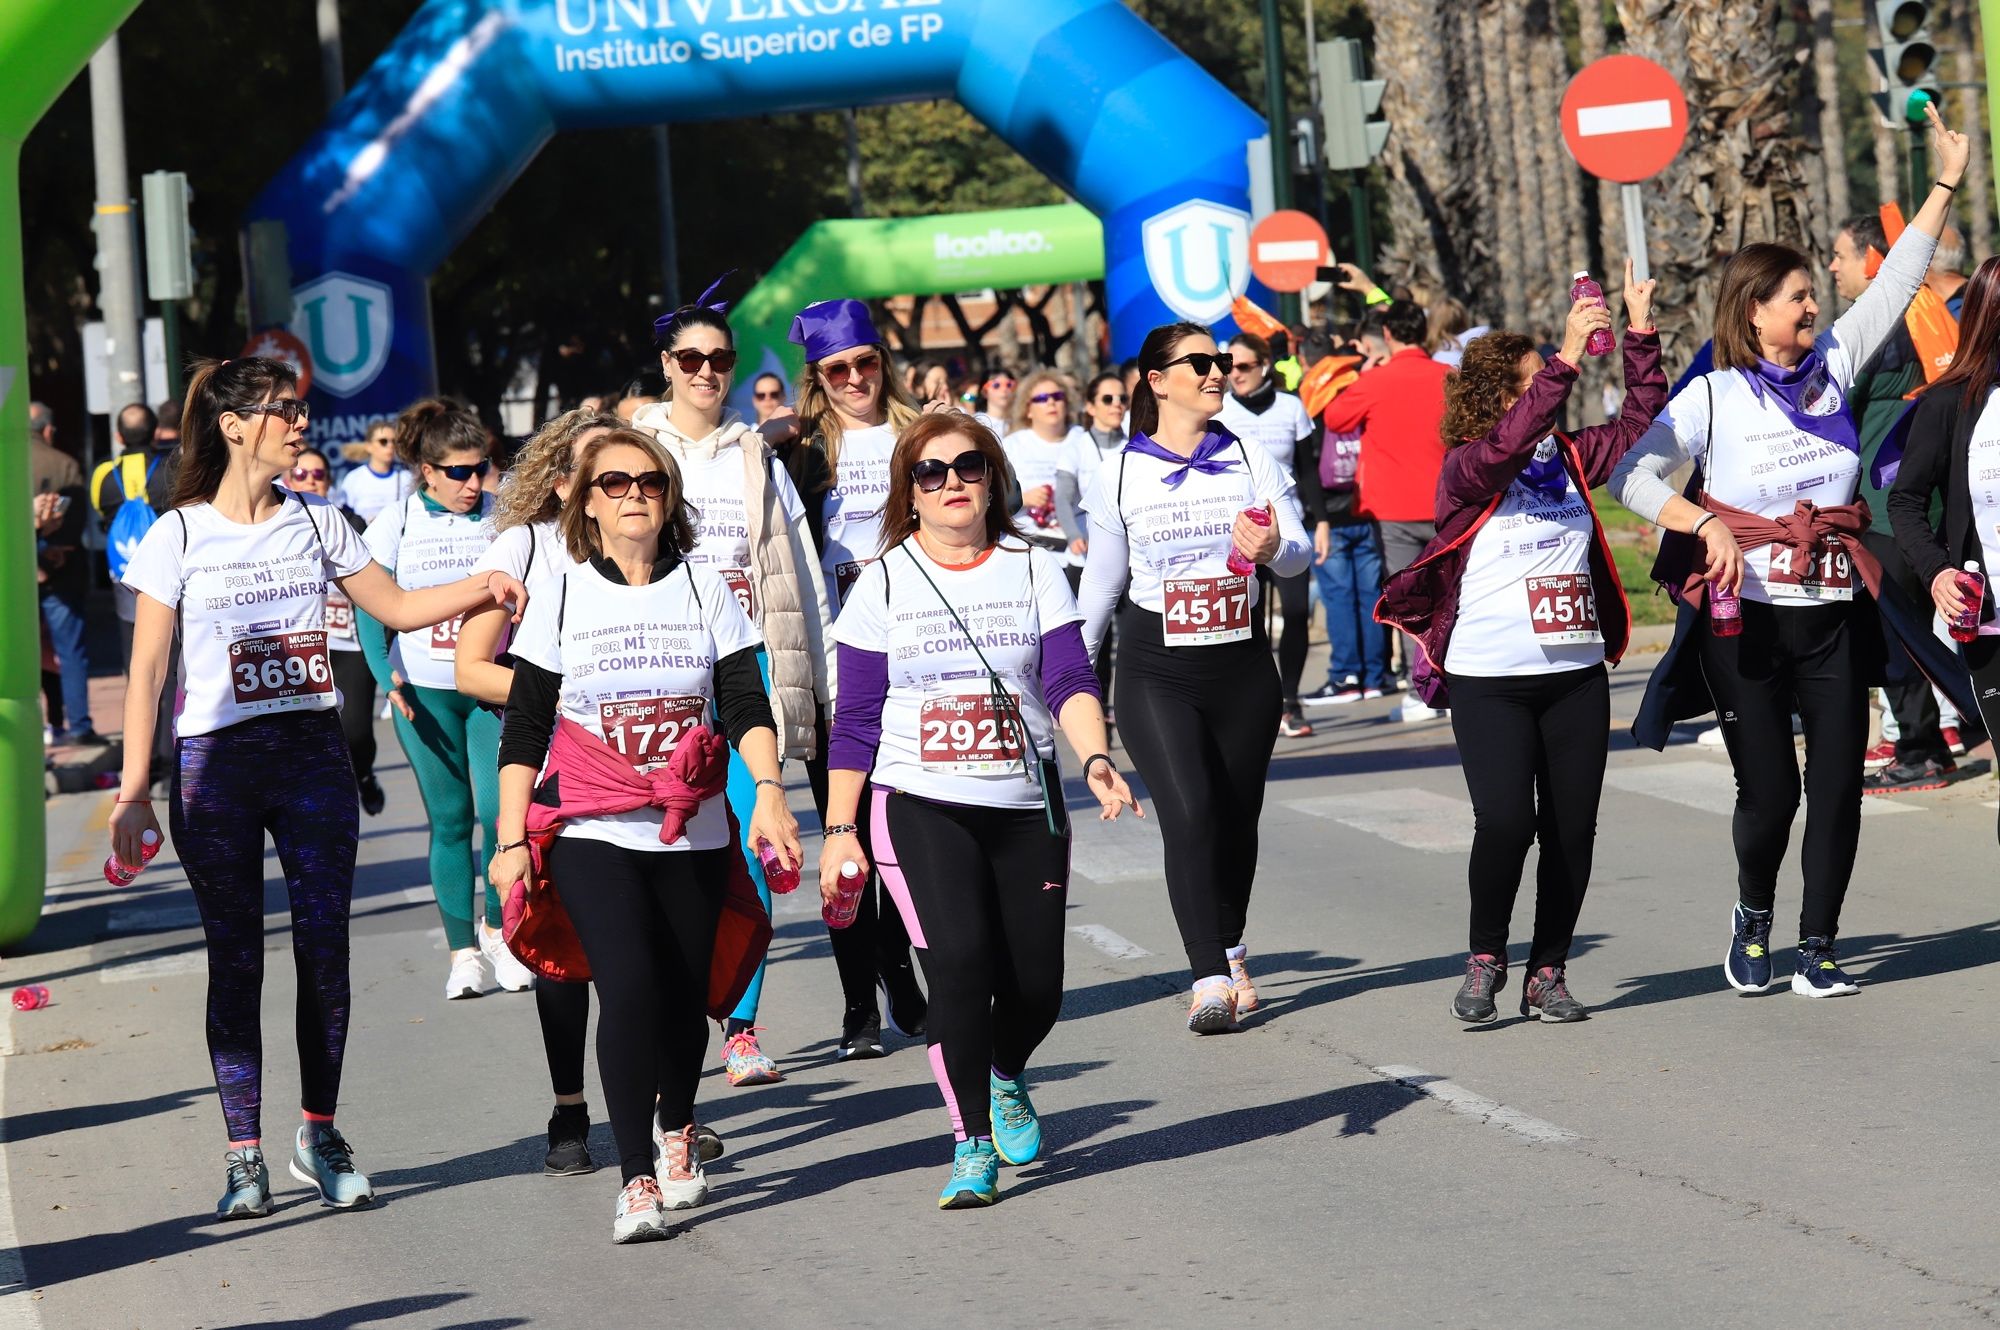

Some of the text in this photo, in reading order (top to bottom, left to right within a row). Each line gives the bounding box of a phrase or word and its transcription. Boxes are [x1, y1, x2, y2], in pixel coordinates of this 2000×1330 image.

[556, 0, 942, 36] UNIVE
[555, 13, 943, 72] Instituto Superior de FP
[1163, 222, 1234, 302] U
[303, 294, 374, 375] U
[1745, 434, 1761, 443] VIII
[1762, 428, 1794, 441] CARRERA
[1767, 432, 1811, 456] POR MÍ
[1979, 439, 1995, 448] VIII
[1751, 442, 1849, 476] MIS COMPAÑE
[849, 467, 867, 480] MÍ
[720, 498, 744, 506] MUJER
[1144, 501, 1177, 512] CARRERA
[1179, 500, 1188, 508] DE
[1191, 498, 1201, 506] LA
[1202, 496, 1226, 504] MUJER
[708, 509, 746, 521] Y POR
[1146, 507, 1230, 528] POR MÍ Y POR
[1499, 517, 1522, 530] MIS
[699, 522, 748, 538] PAÑER
[439, 543, 454, 555] MÍ
[203, 553, 305, 574] VIII CARRERA DE LA MUJER
[1771, 548, 1849, 579] 419
[225, 565, 313, 588] POR MÍ Y POR
[1217, 576, 1245, 587] MURCIA
[1803, 579, 1826, 587] ELOISA
[206, 581, 327, 610] MIS COMPAÑERAS
[1181, 583, 1210, 597] mujer
[1545, 579, 1571, 594] mujer
[896, 613, 913, 622] VIII
[958, 605, 970, 614] DE
[972, 603, 984, 612] LA
[985, 601, 1013, 610] MUJER
[1167, 593, 1247, 625] 4517
[1532, 594, 1598, 624] 4515
[572, 631, 589, 641] VIII
[591, 625, 631, 638] CARRERA
[634, 623, 645, 631] DE
[647, 623, 658, 631] LA
[661, 623, 687, 632] MUJER
[916, 614, 1017, 637] POR MÍ Y POR
[288, 633, 323, 644] MURCIA
[592, 631, 691, 656] POR MÍ Y POR
[895, 630, 1036, 660] MIS COMPAÑERAS
[250, 641, 281, 657] mujer
[235, 653, 329, 692] 3696
[572, 651, 711, 679] MIS COMPAÑERAS
[279, 689, 297, 697] ESTY
[664, 698, 703, 708] MURCIA
[942, 700, 976, 716] mujer
[622, 705, 656, 721] mujer
[923, 719, 1021, 751] 2923
